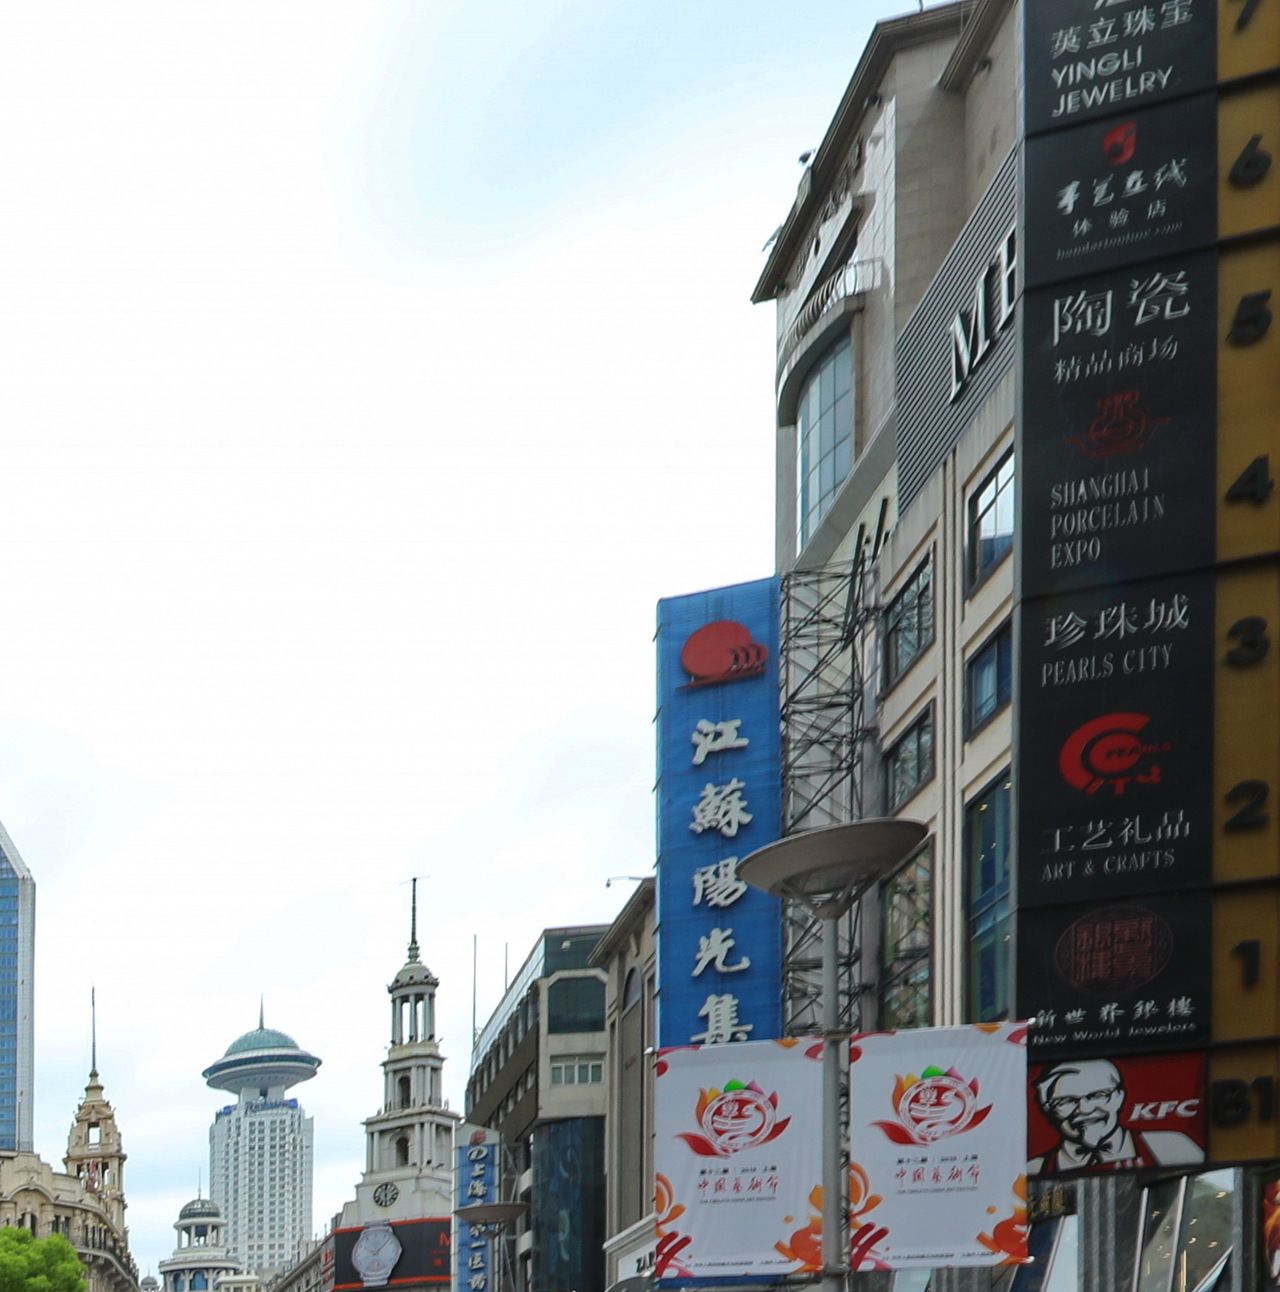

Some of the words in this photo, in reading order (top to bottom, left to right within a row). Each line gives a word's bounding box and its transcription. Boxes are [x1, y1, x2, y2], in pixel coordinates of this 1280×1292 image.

[1051, 0, 1192, 58] 英立珠宝
[1051, 45, 1143, 88] YINGLI
[1051, 65, 1173, 118] JEWELRY
[1228, 133, 1272, 190] 6
[1072, 199, 1167, 238] 体验店
[1053, 270, 1191, 347] 陶瓷
[1226, 290, 1273, 347] 5
[1050, 467, 1150, 509] SHANGHAI
[1226, 454, 1274, 506] 4
[1050, 494, 1166, 540] PORCELAIN
[1050, 537, 1101, 569] EXPO
[1044, 594, 1190, 648] 珍珠城
[1225, 616, 1271, 670] 3
[1041, 652, 1115, 688] PEARLS
[1122, 643, 1173, 674] CITY
[1043, 809, 1190, 852] 工艺礼品
[1224, 779, 1270, 834] 2
[1041, 860, 1077, 882] ART
[1083, 857, 1095, 874] &
[1103, 849, 1175, 874] CRAFTS
[1231, 939, 1261, 988] 1
[1032, 1033, 1067, 1047] New
[1074, 1026, 1121, 1041] World
[1128, 1021, 1197, 1037] Jewelers
[1129, 1098, 1200, 1122] KFC
[1213, 1074, 1275, 1127] B1
